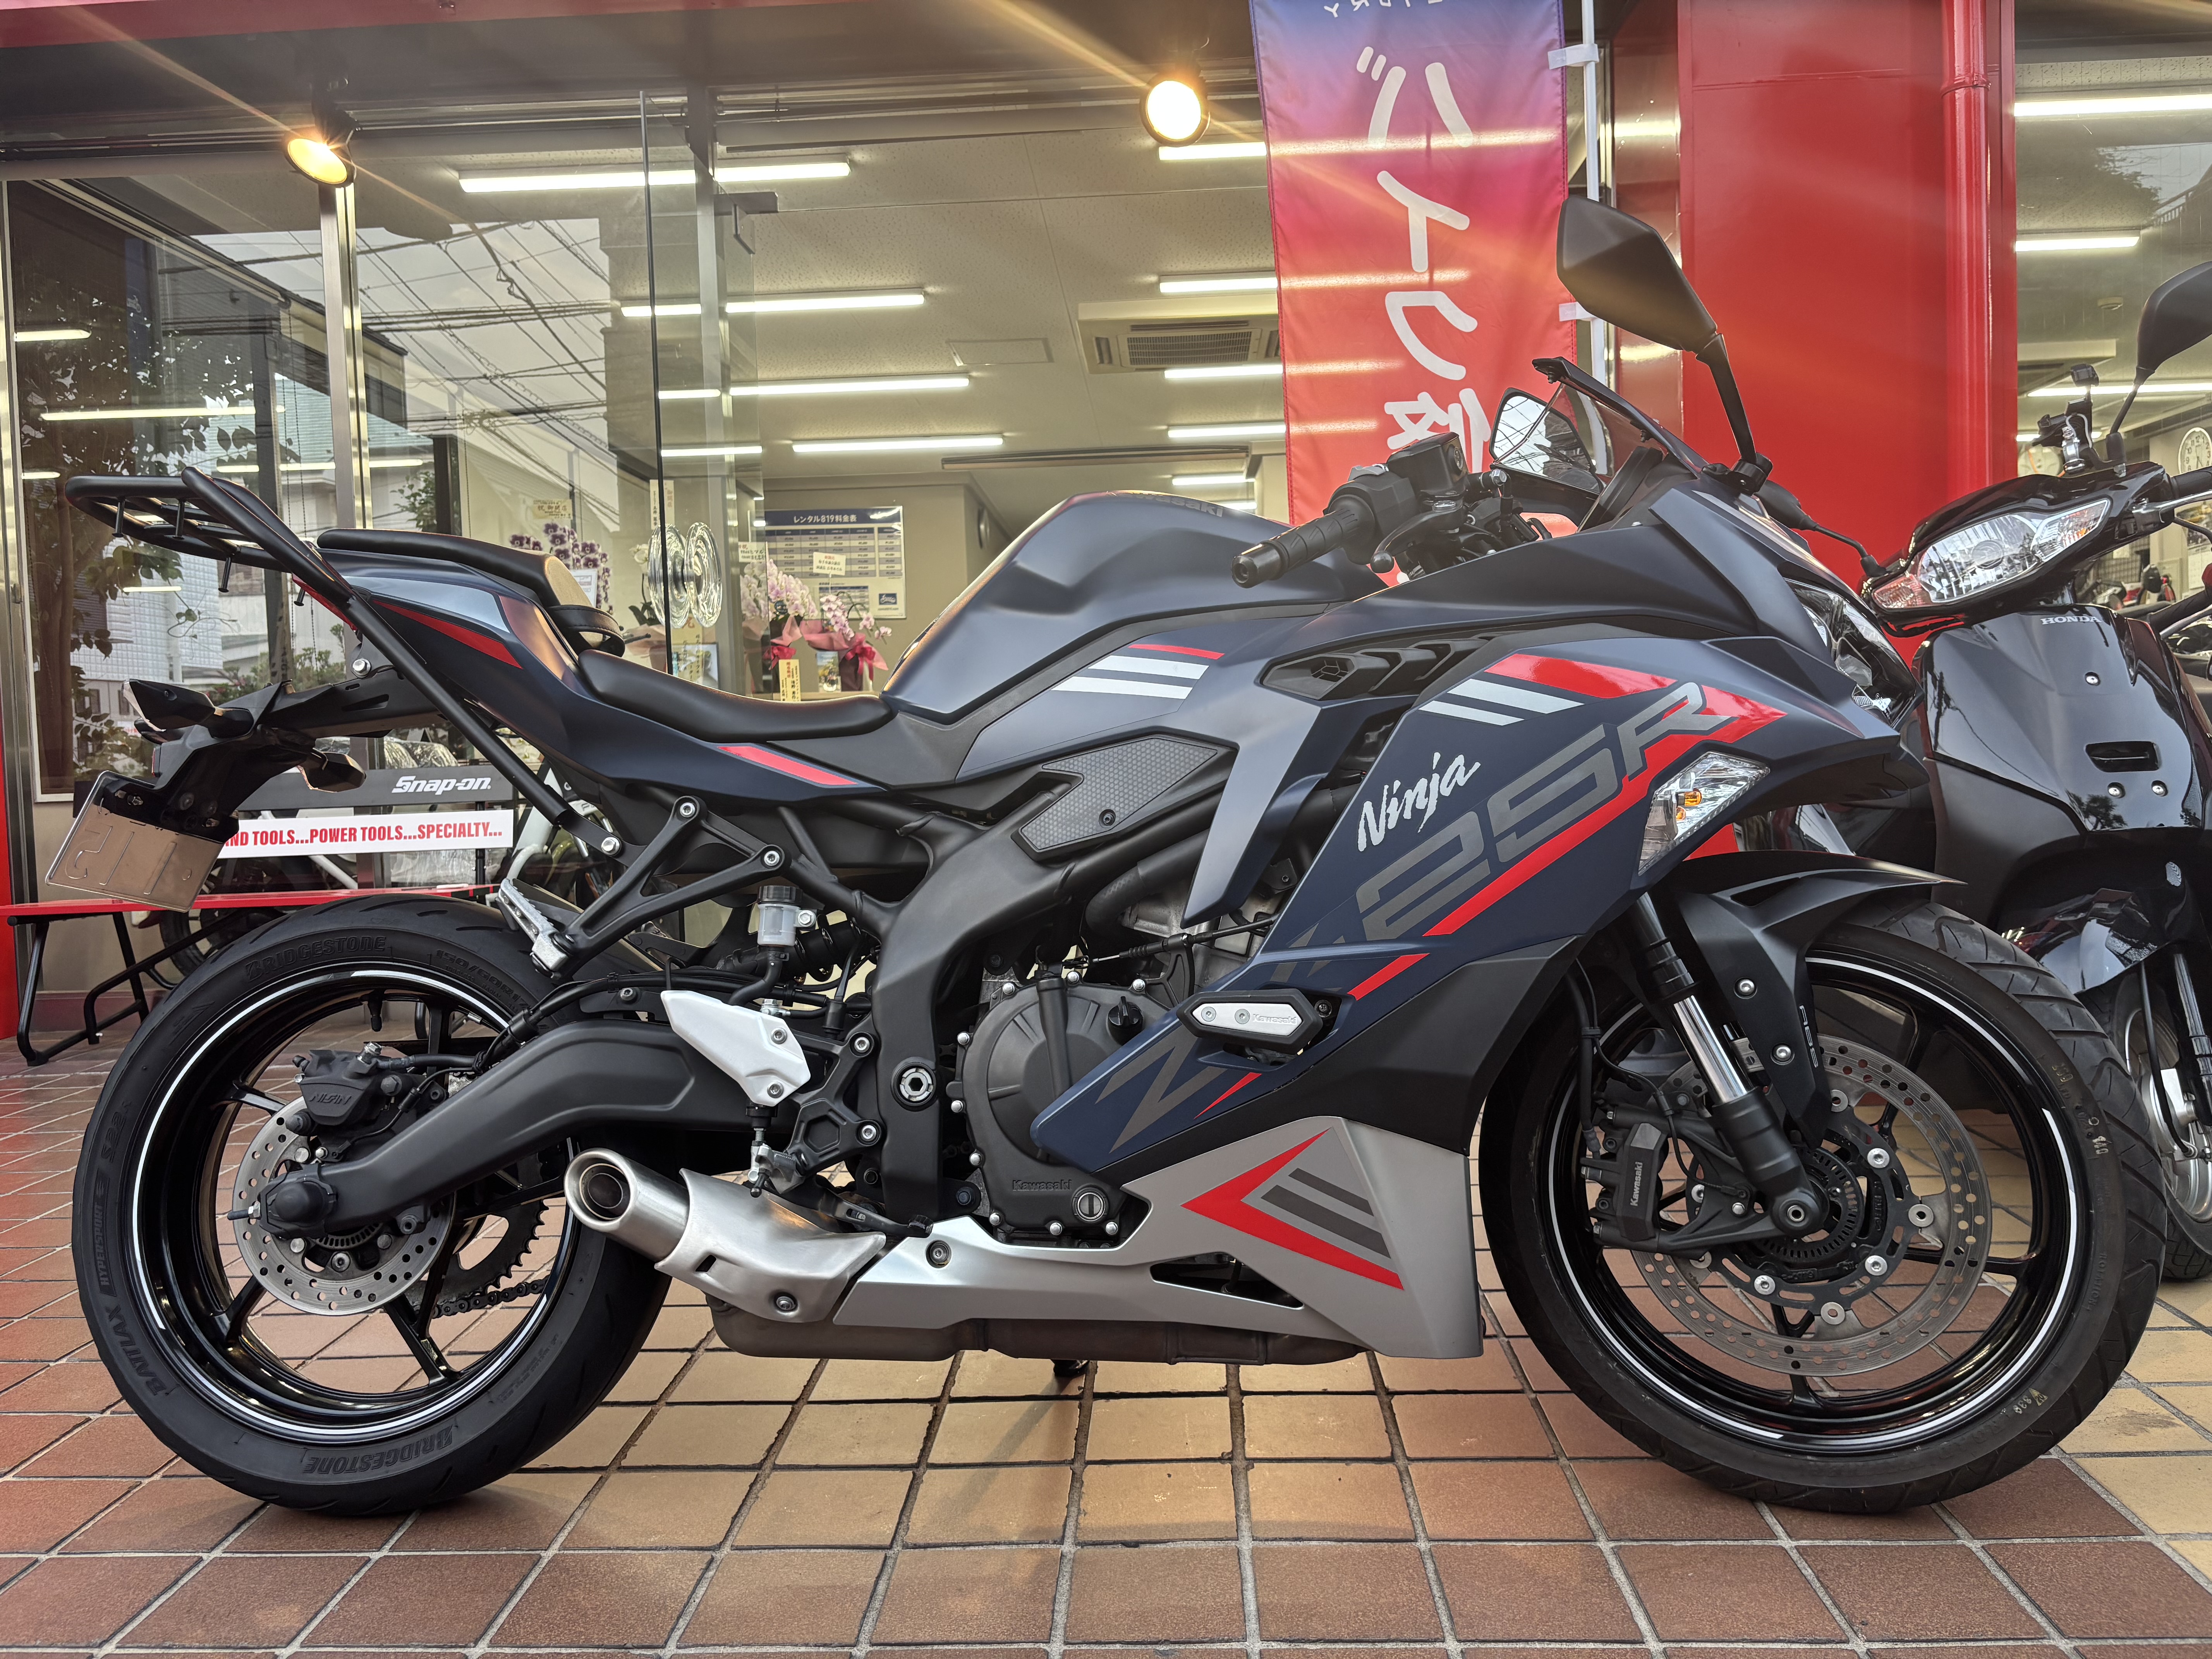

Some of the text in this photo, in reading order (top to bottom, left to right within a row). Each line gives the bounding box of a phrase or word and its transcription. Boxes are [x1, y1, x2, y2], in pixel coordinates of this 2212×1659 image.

[2040, 615, 2102, 625] HONDA
[1357, 752, 1481, 852] Ninja
[225, 832, 249, 847] ND
[245, 935, 386, 982] BRIDGESTONE
[1252, 1013, 1298, 1025] Kawasaki
[1799, 1005, 1819, 1068] ABS
[1012, 1179, 1072, 1191] Kawasaki
[1630, 1161, 1643, 1206] Kawasaki
[94, 1204, 110, 1286] HYPERSPORT
[105, 1305, 167, 1396] BATLAX
[302, 1424, 454, 1474] BRIDGESTONE
